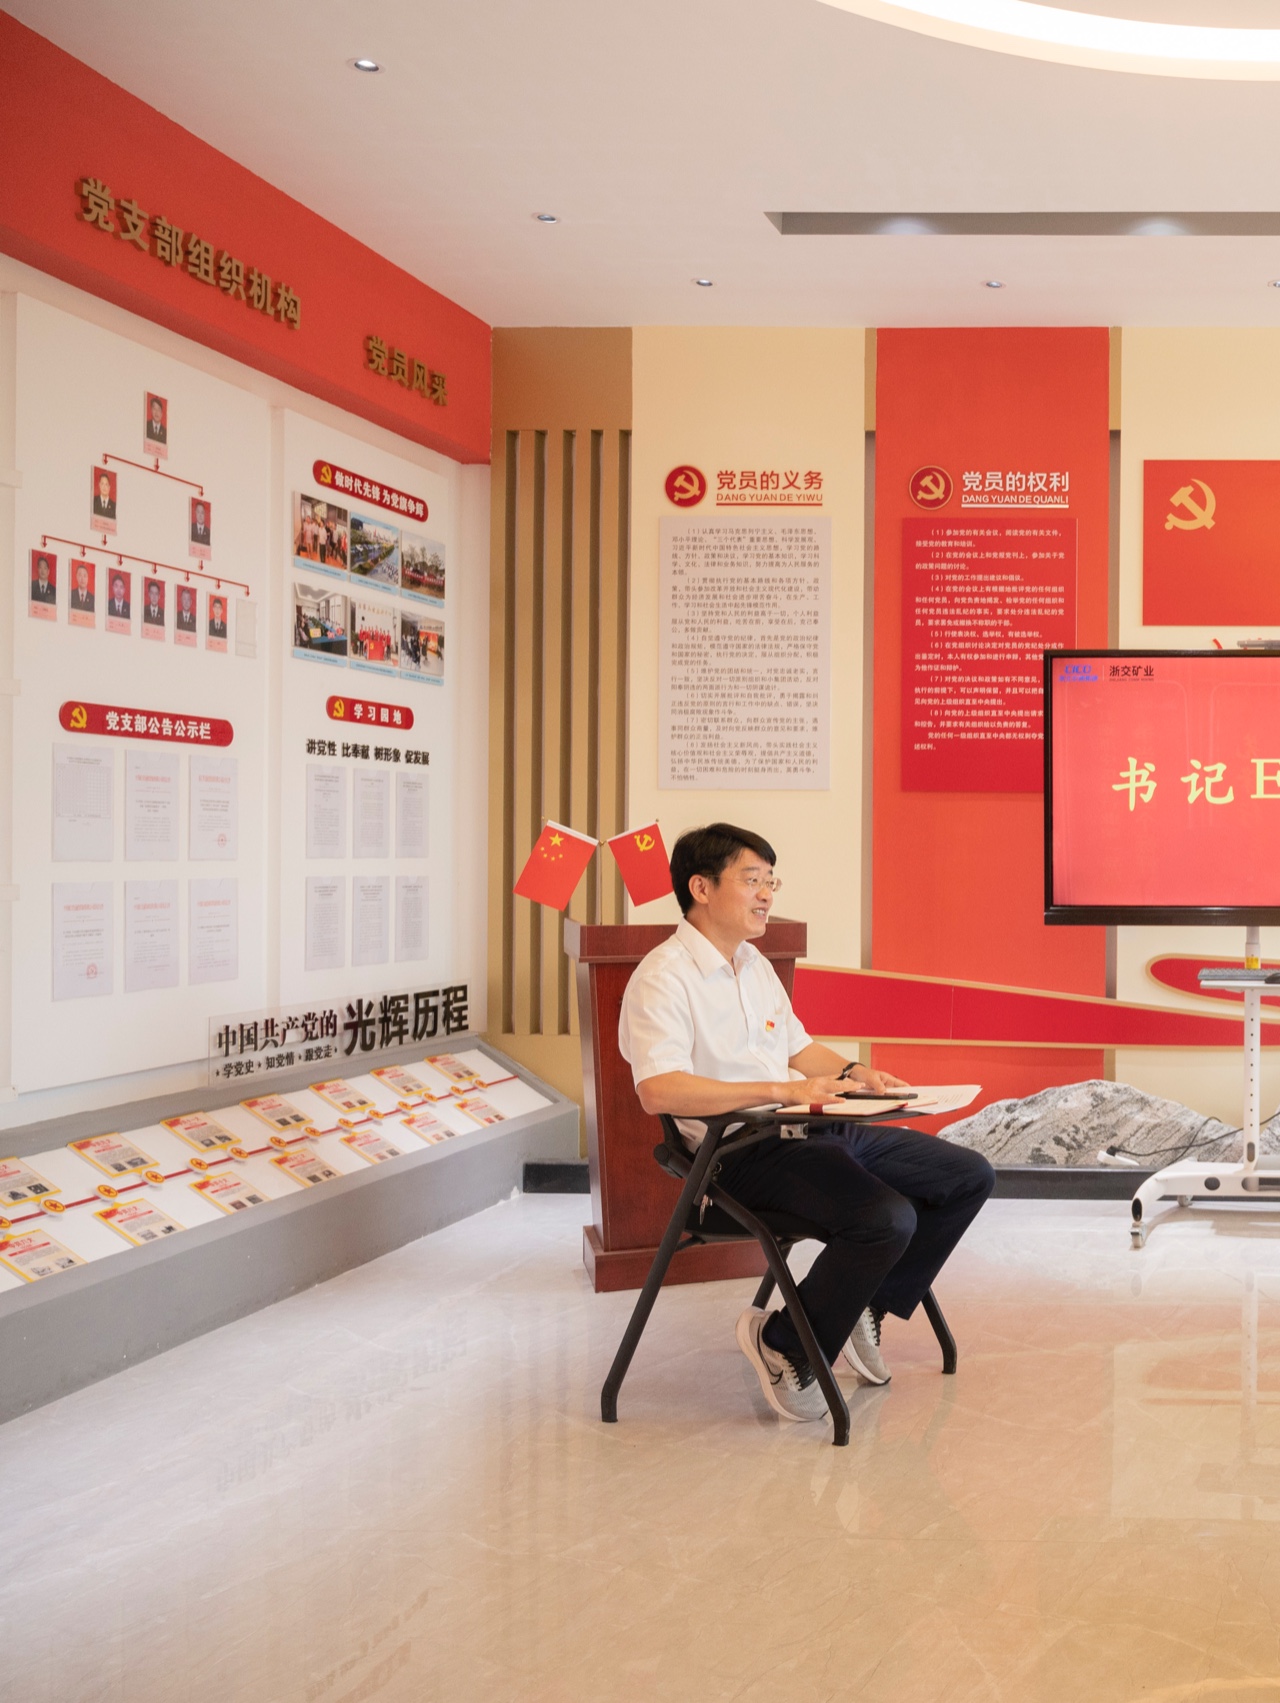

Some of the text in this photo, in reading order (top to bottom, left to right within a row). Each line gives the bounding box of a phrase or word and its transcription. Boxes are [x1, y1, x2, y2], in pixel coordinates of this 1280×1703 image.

[78, 176, 303, 331] 党支部组织机构
[366, 335, 450, 407] 党员风采
[334, 470, 425, 518] 做时代先锋 为党旗争辉
[716, 470, 824, 491] 党员的义务
[961, 470, 1070, 492] 党员的权利
[716, 493, 823, 503] DANG YUAN DE YIWU
[962, 494, 1069, 504] DANG YUAN DE QUANLI
[1109, 665, 1154, 677] 浙交矿业
[105, 710, 212, 740] 党支部公告公示栏
[353, 703, 402, 725] 学习园地
[305, 738, 430, 766] 讲党性 比奉献 树形象 促发展
[217, 984, 470, 1057] 中国共产党的 光辉历程
[222, 1058, 255, 1079] 学党史
[265, 1050, 295, 1071] 知党情
